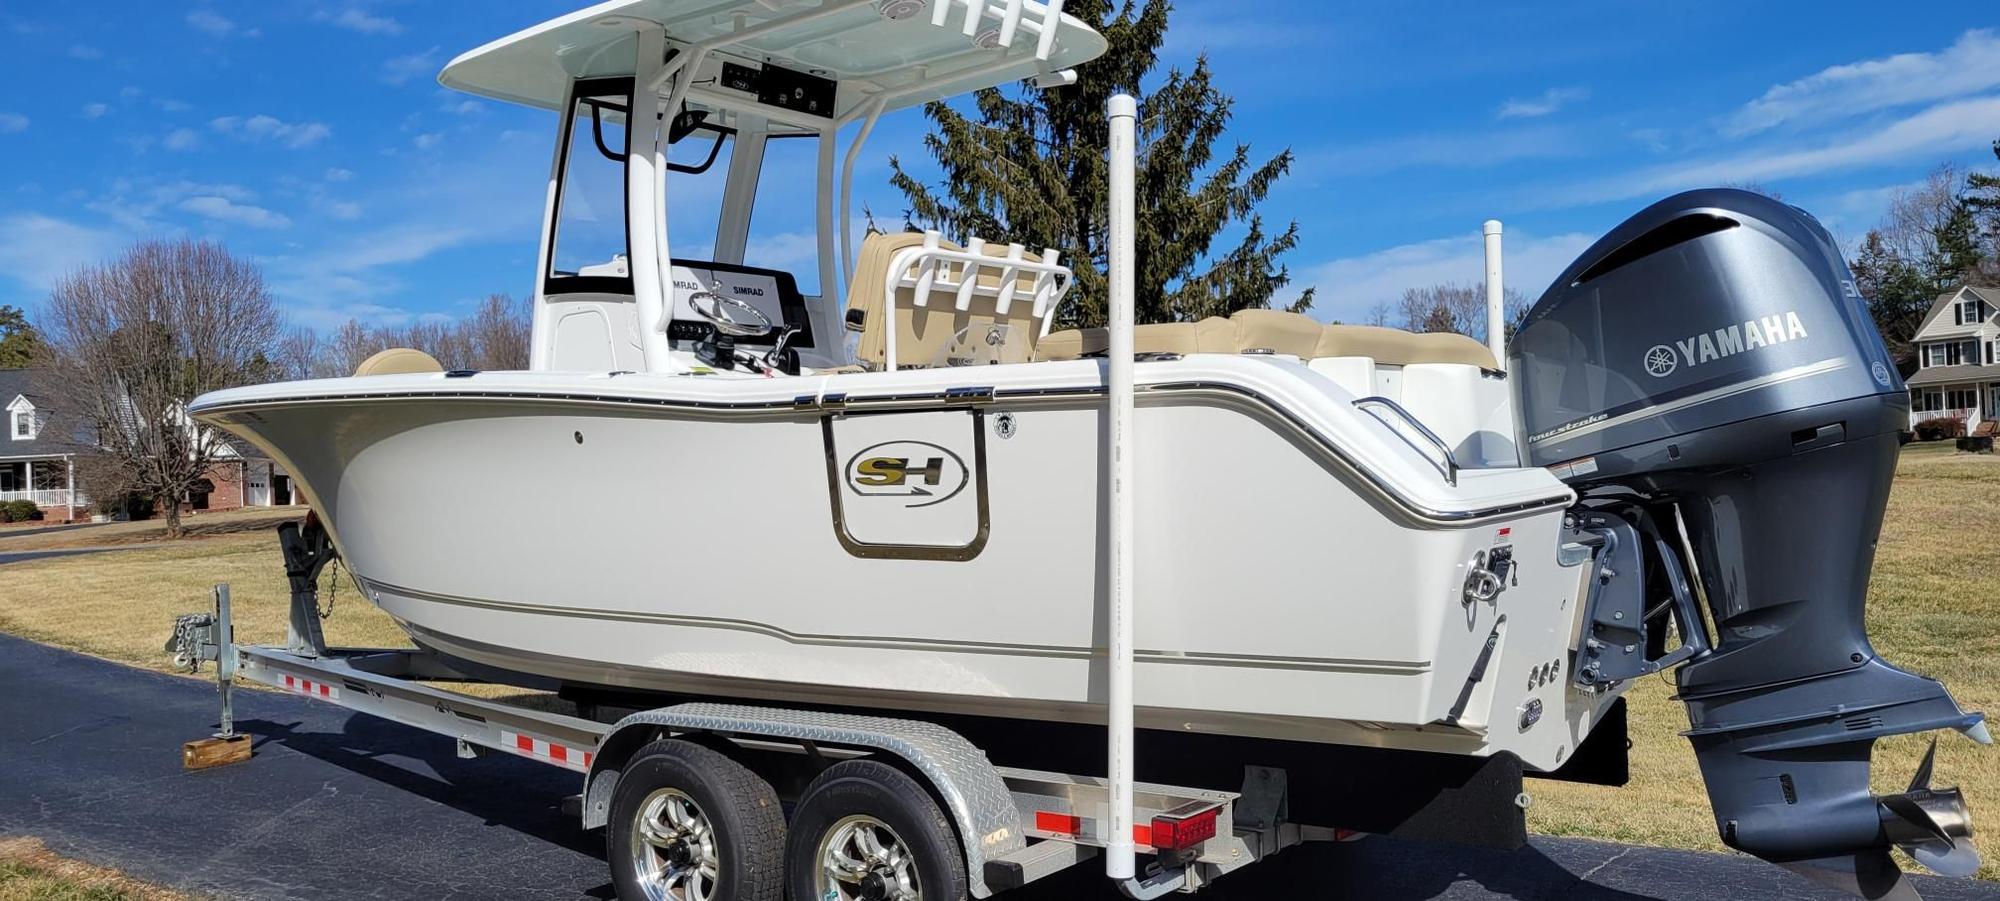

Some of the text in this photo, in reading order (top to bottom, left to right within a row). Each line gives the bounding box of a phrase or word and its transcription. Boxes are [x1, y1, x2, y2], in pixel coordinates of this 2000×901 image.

[673, 281, 699, 291] MRAD
[733, 286, 764, 297] SIMRAD
[1676, 311, 1808, 367] YAMAHA
